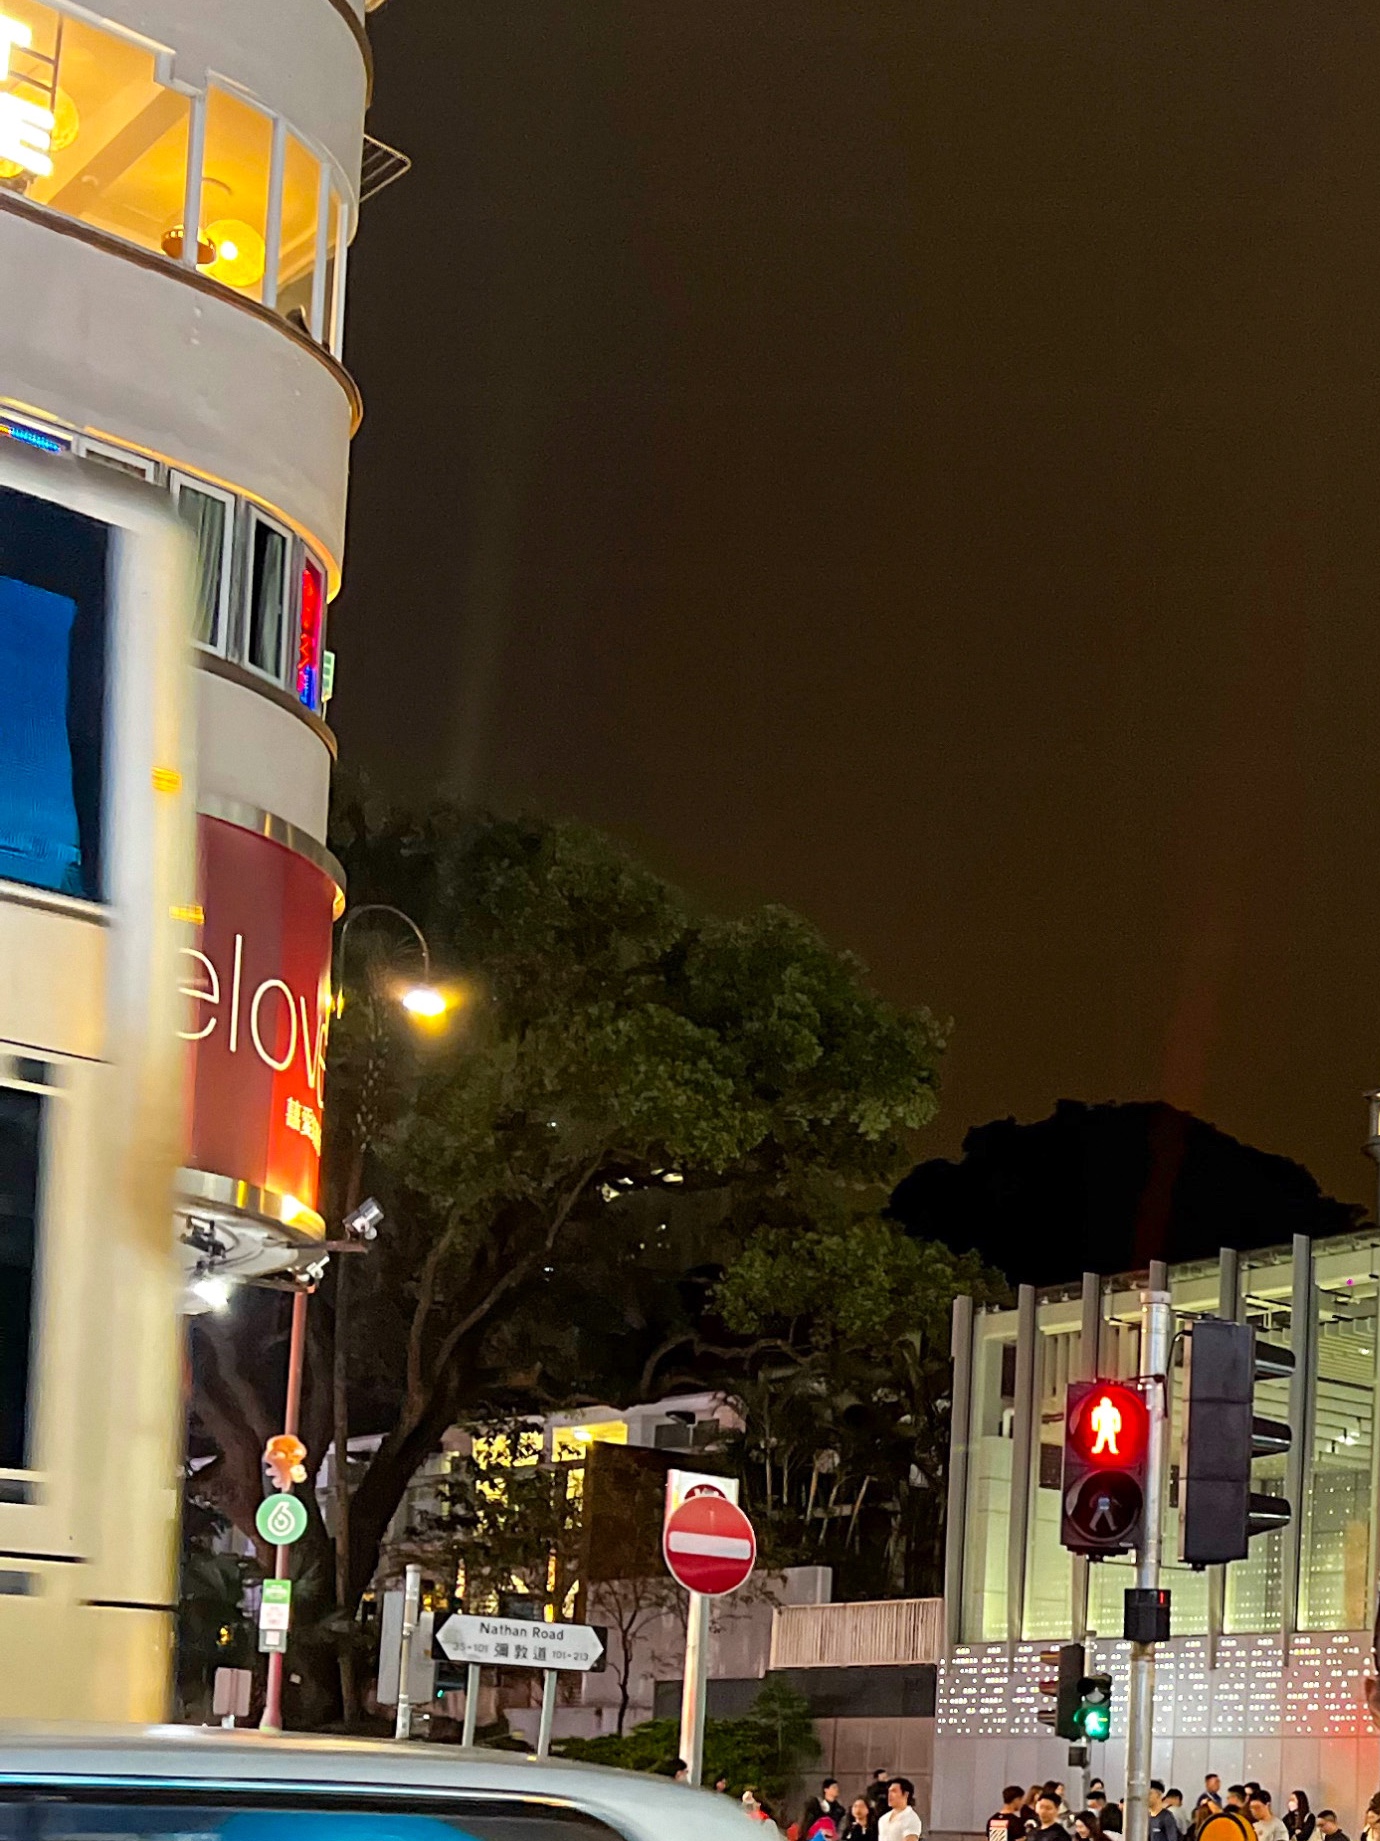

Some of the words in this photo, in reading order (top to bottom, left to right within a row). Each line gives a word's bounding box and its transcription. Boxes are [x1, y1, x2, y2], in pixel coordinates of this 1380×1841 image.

[479, 1622, 527, 1638] Nathan
[532, 1626, 564, 1641] Road
[493, 1642, 547, 1661] 彌敦道
